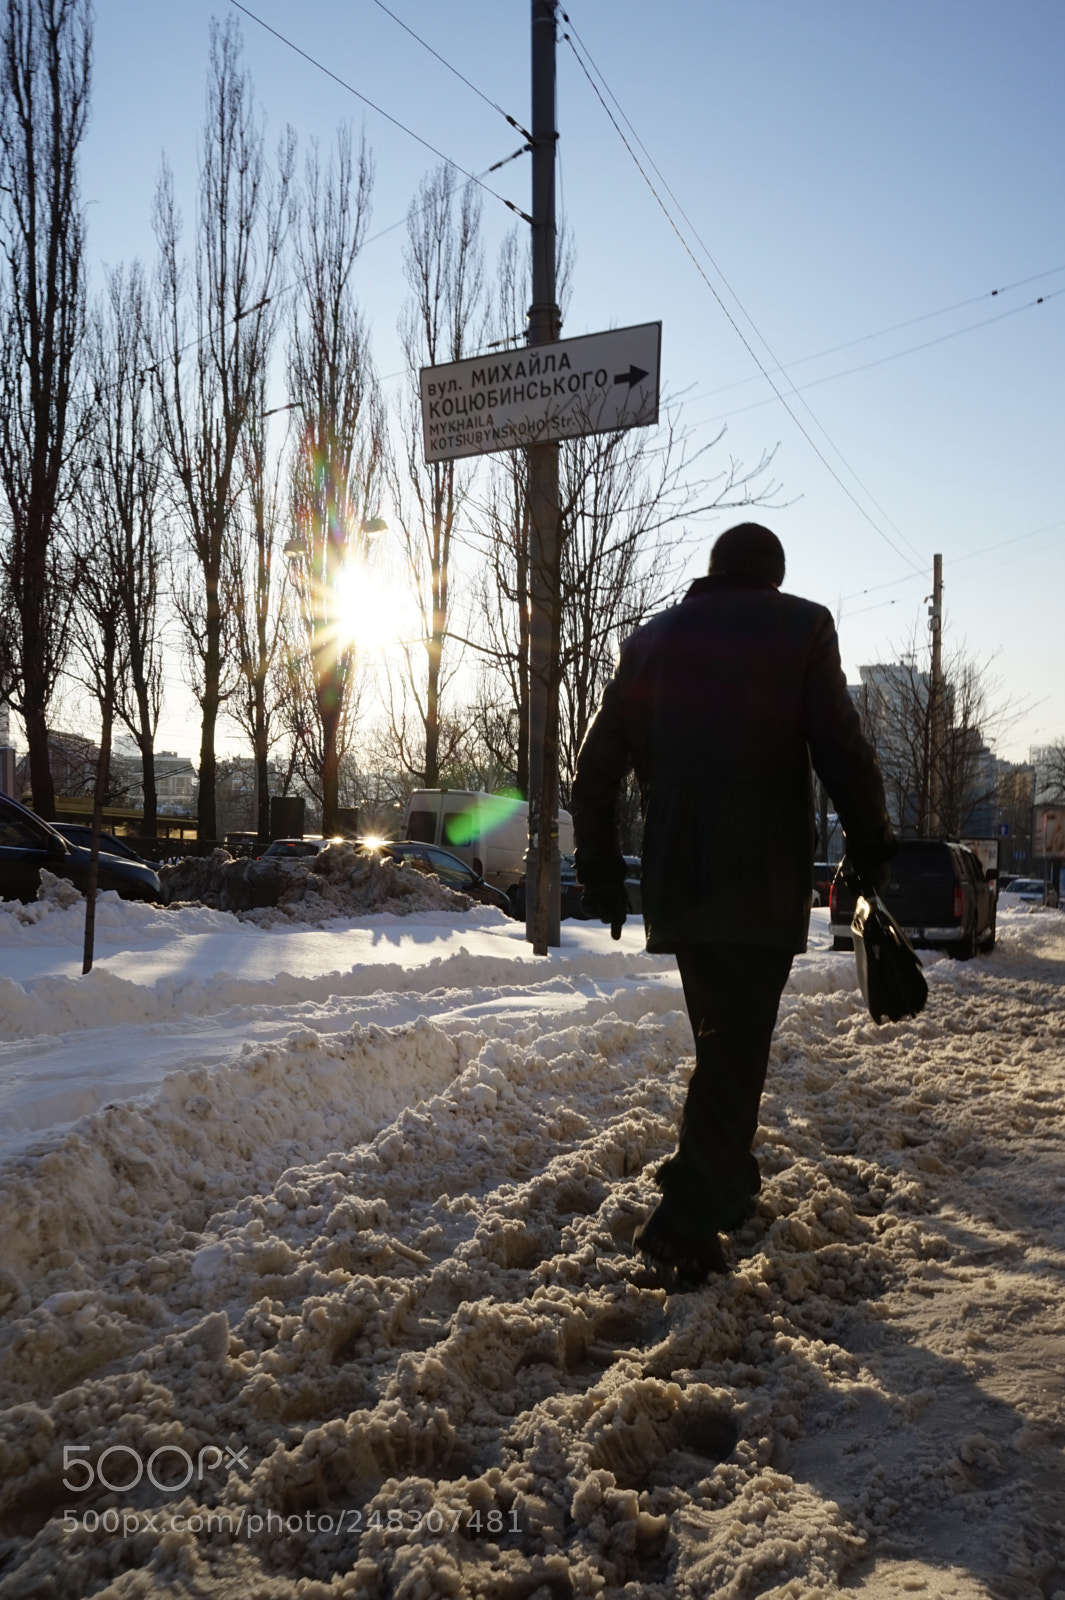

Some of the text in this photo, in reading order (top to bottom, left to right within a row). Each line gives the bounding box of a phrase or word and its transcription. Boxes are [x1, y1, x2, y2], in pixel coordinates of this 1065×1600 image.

[427, 352, 572, 399] вул. МИХАЙЛА
[429, 368, 608, 419] КОЦЮБИНСЬКОГО
[429, 413, 495, 437] MYKHAILA
[551, 415, 576, 430] Str.
